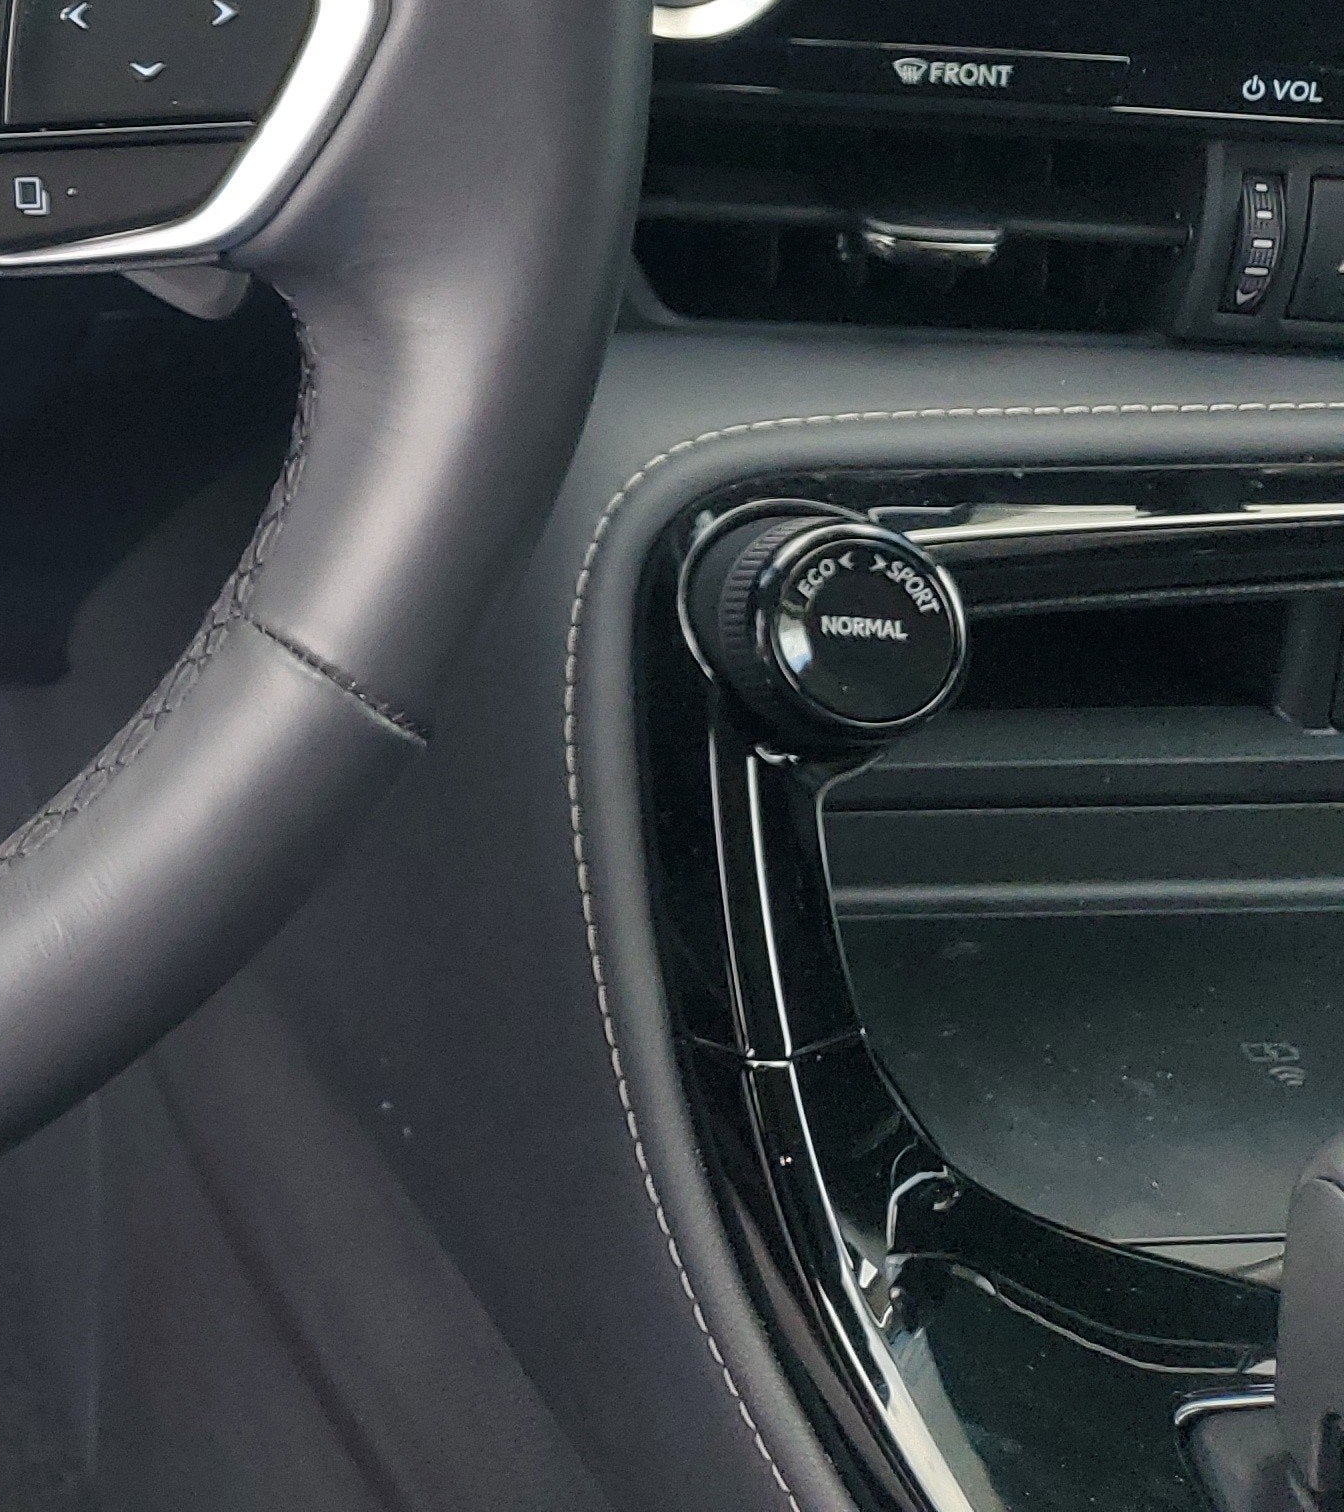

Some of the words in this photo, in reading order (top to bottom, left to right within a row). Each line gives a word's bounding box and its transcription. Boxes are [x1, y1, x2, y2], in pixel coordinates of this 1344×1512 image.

[928, 62, 1013, 88] FRONT
[1273, 80, 1323, 105] VOL
[798, 558, 836, 600] ECO
[886, 560, 940, 615] SPORT
[821, 615, 909, 641] NORMAL
